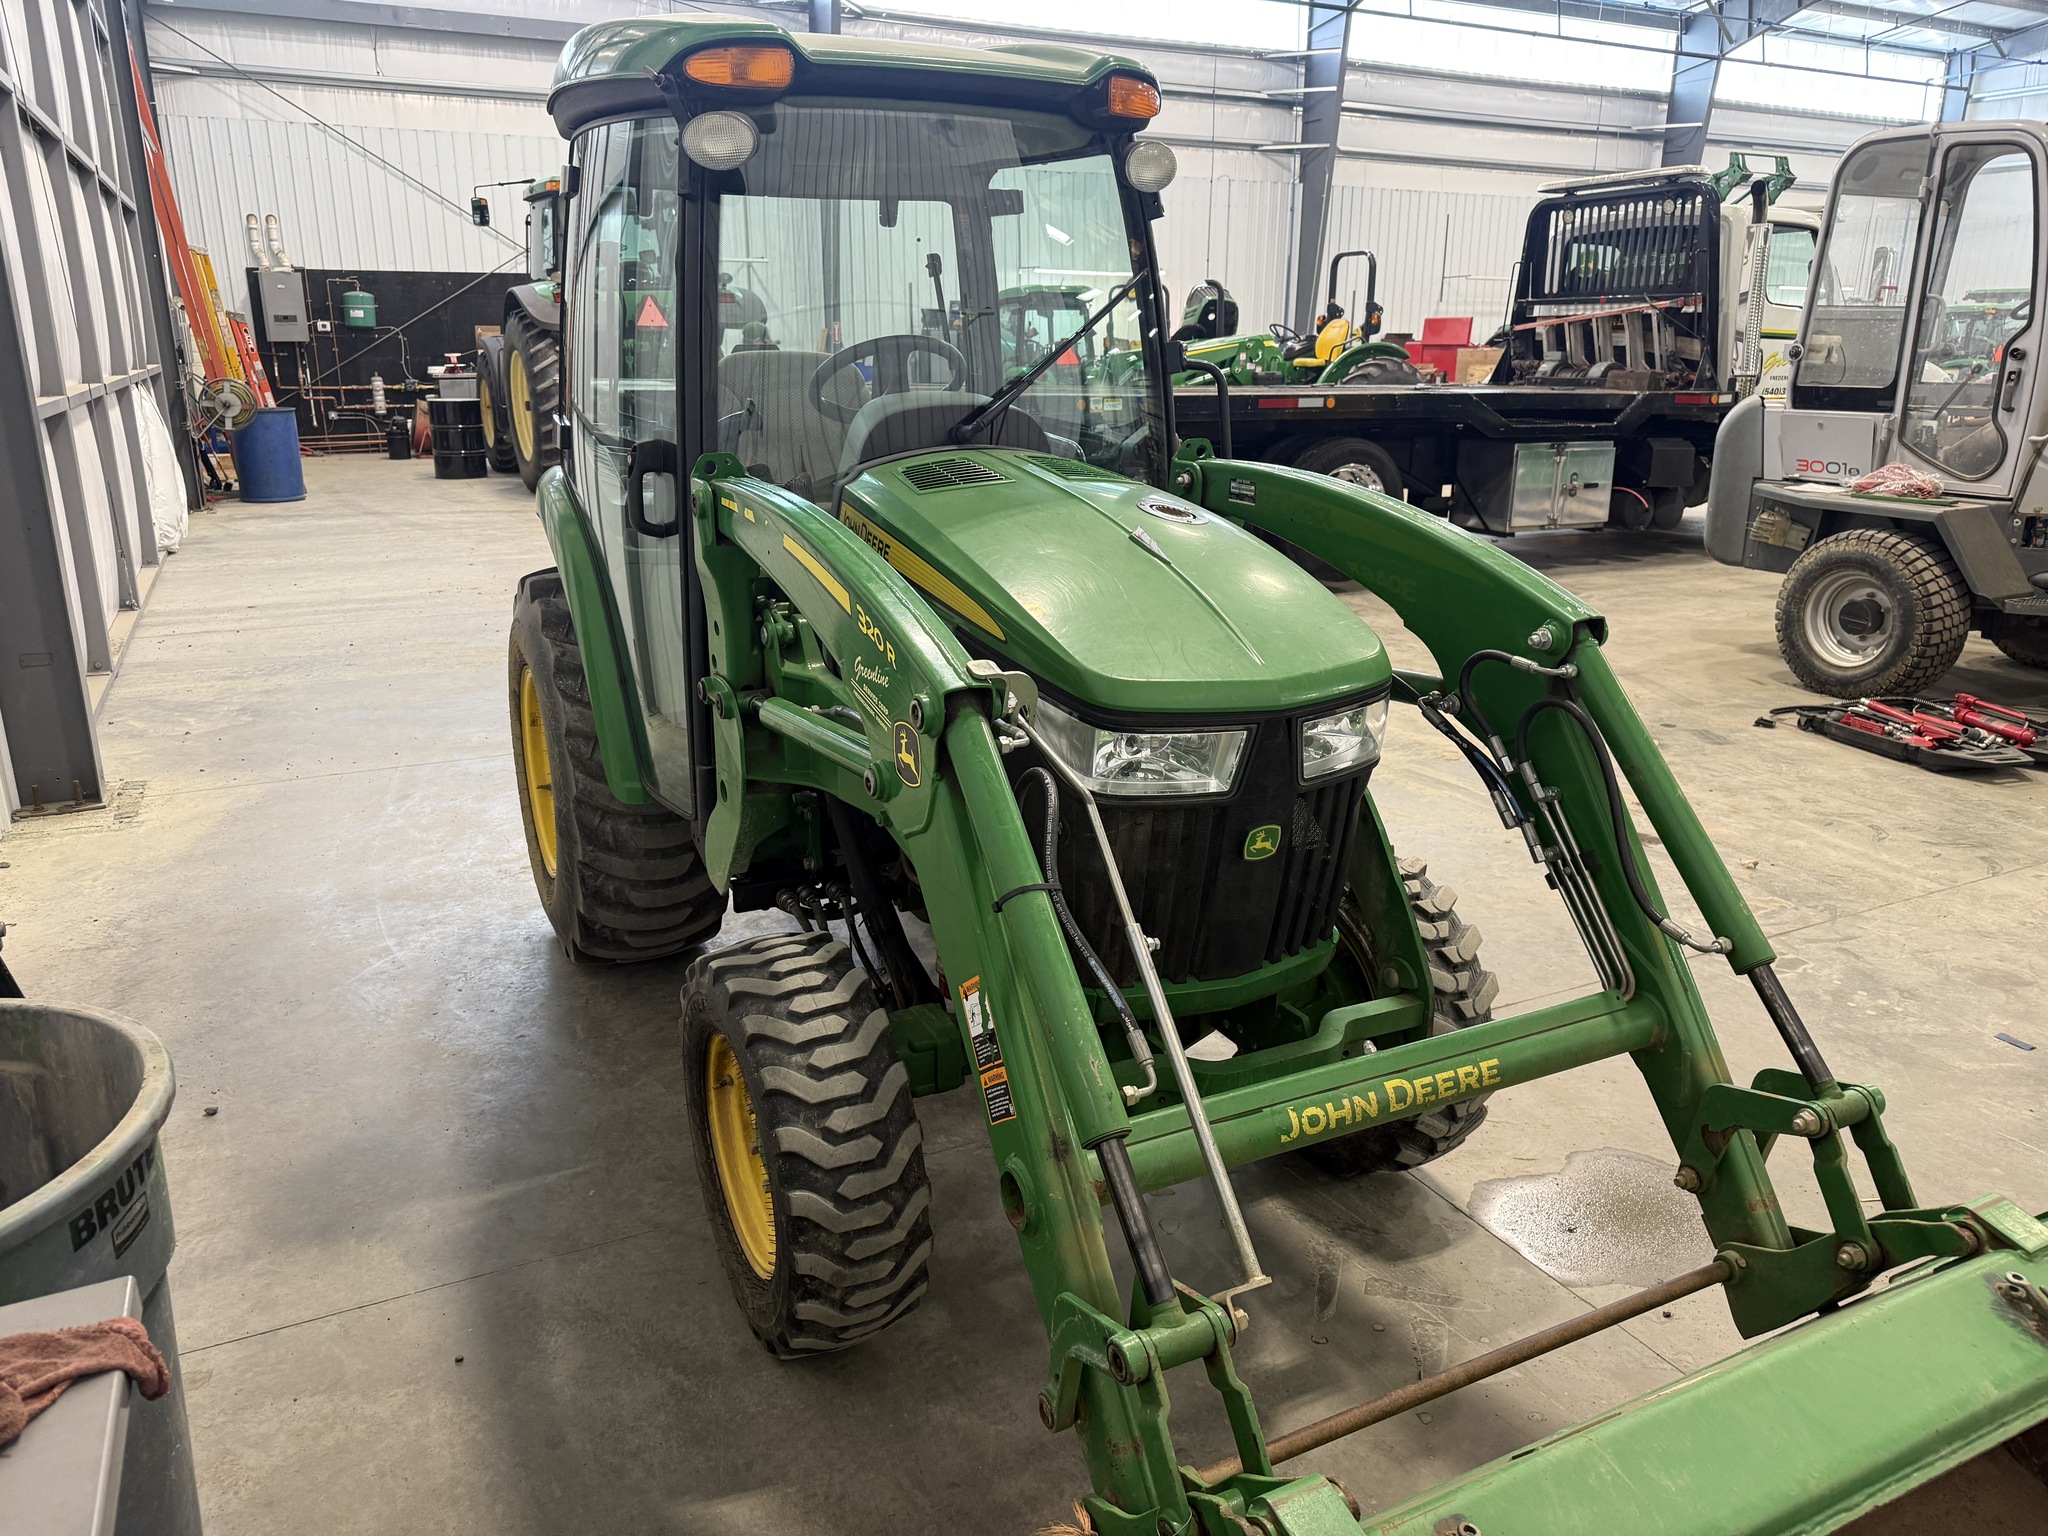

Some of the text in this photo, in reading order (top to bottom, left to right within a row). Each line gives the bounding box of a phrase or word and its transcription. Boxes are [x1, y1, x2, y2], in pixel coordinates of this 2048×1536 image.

[844, 510, 891, 562] JOHN DEERE
[855, 656, 889, 688] Greenline
[1280, 1058, 1502, 1144] JOHN DEERE
